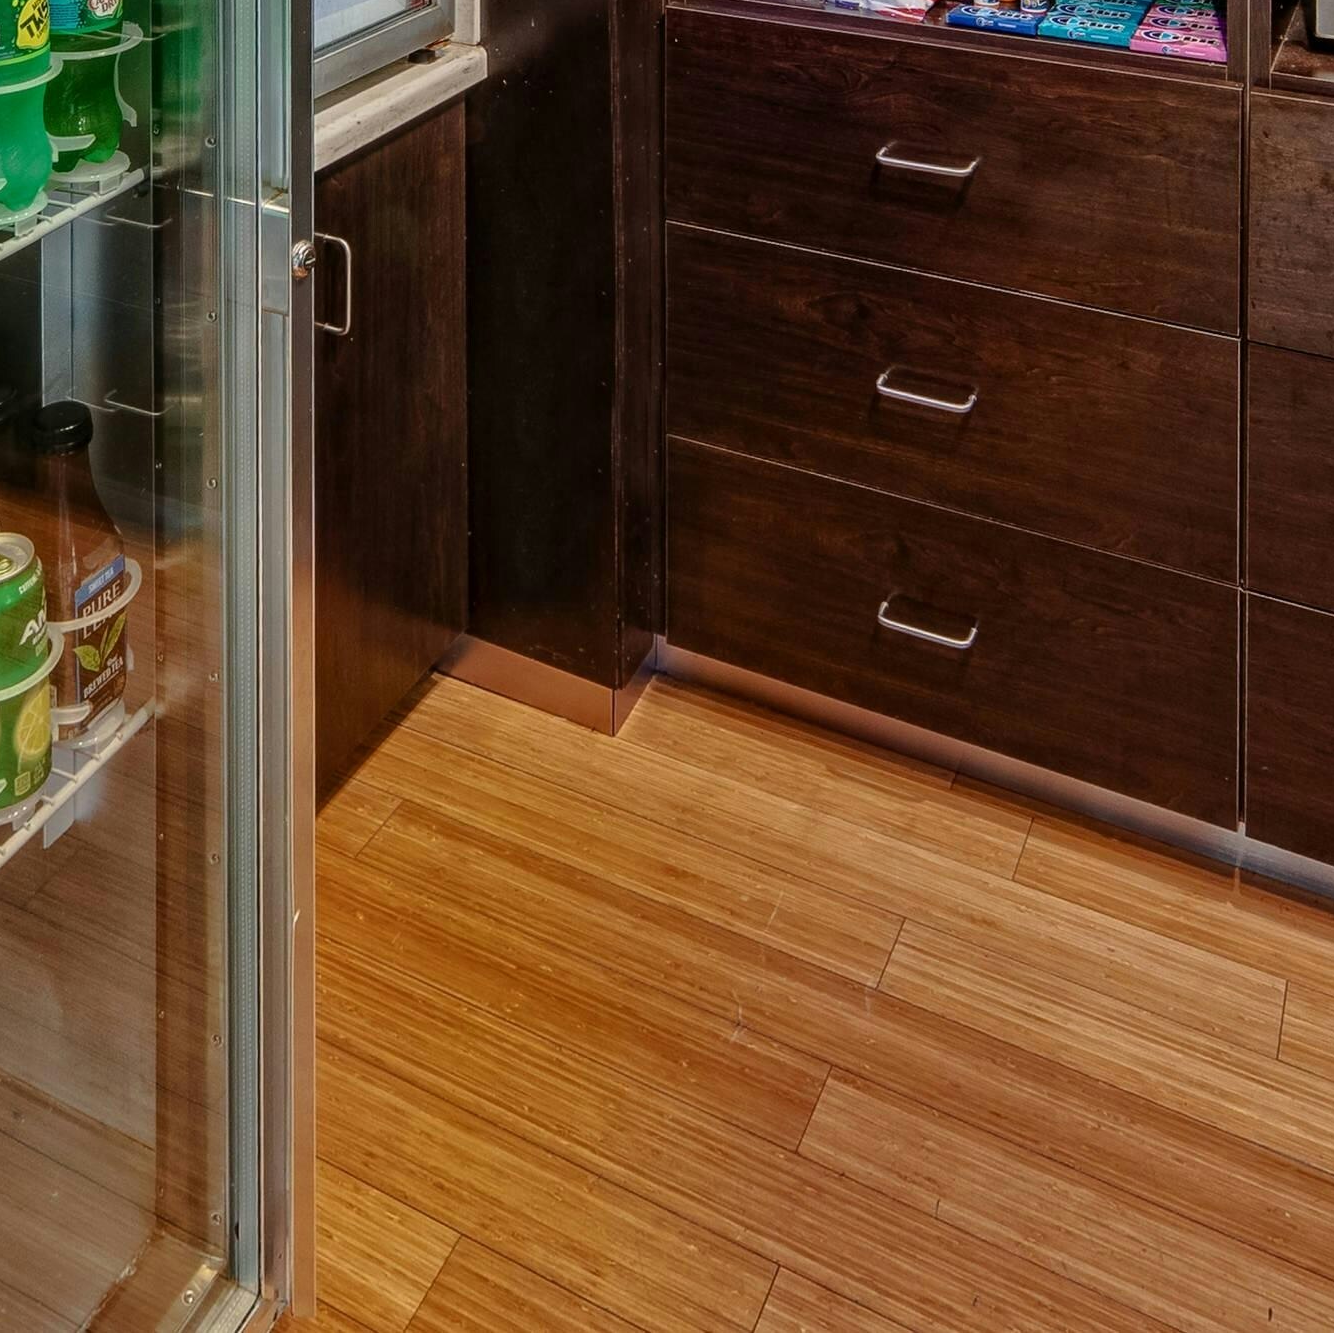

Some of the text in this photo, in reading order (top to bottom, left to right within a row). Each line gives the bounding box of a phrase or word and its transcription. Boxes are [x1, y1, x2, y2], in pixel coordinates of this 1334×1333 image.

[82, 579, 122, 618] PURE
[83, 656, 124, 699] BREWED TEA
